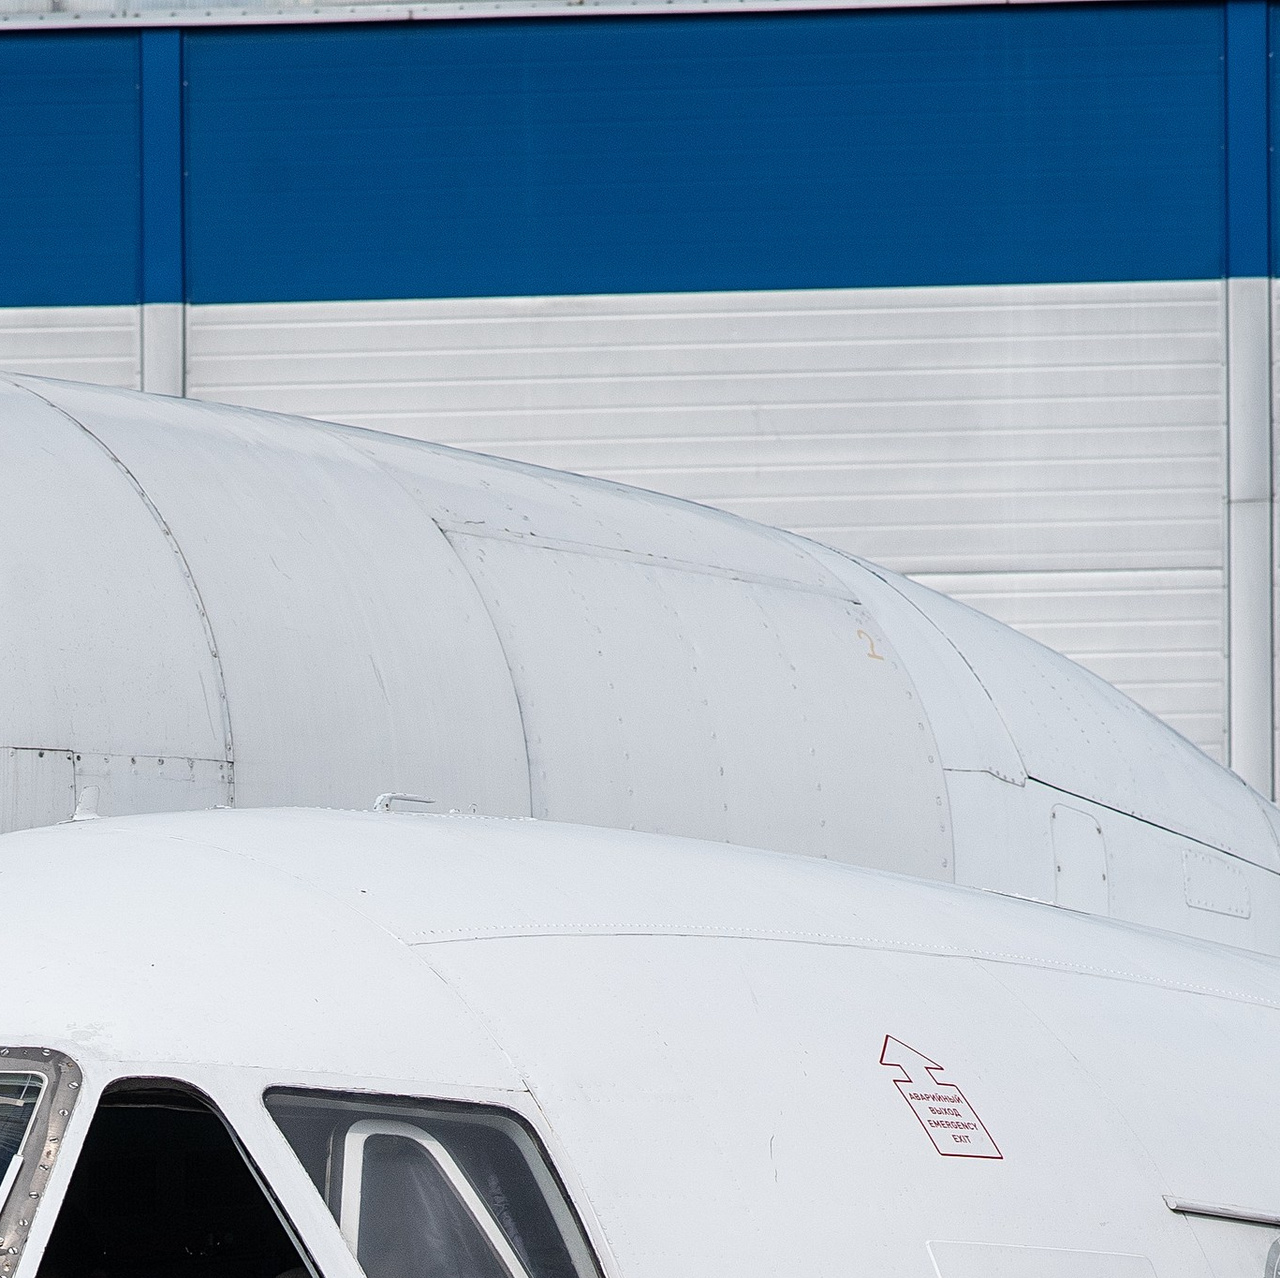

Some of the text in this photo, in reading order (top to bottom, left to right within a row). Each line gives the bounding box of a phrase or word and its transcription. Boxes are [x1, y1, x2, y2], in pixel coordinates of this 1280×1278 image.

[908, 1092, 963, 1104] АВАРИЙНЫЙ
[928, 1106, 962, 1118] ВЫХОД
[927, 1119, 978, 1130] EMERGENCY
[951, 1134, 971, 1144] EXIT
